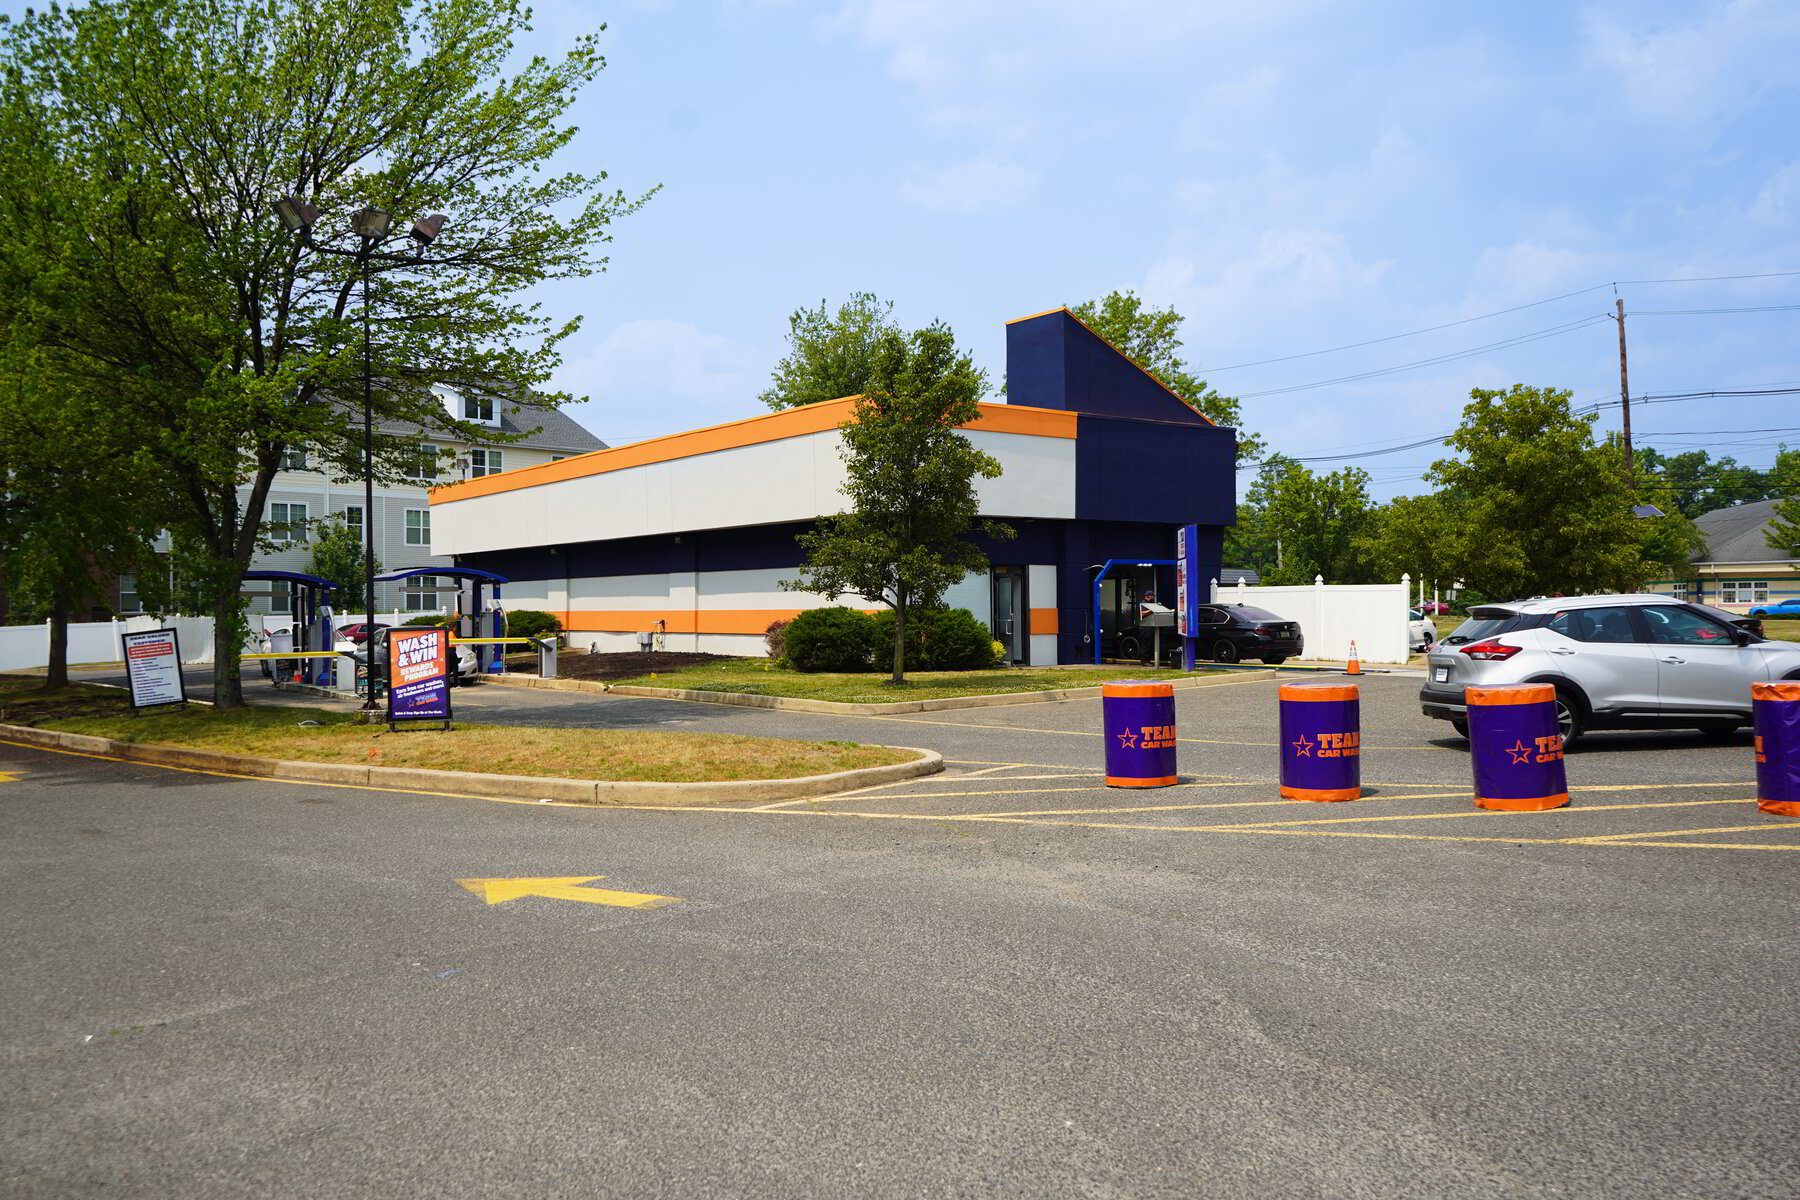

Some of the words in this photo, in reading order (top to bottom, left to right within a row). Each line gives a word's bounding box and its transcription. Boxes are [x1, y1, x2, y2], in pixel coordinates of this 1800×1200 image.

[397, 632, 438, 654] WASH
[398, 653, 409, 667] &
[409, 645, 438, 664] WIN
[400, 661, 435, 677] REWARDS
[404, 667, 439, 682] PROGRAM
[1140, 741, 1161, 749] CAR
[1317, 749, 1341, 758] CAR
[1535, 752, 1557, 763] CAR
